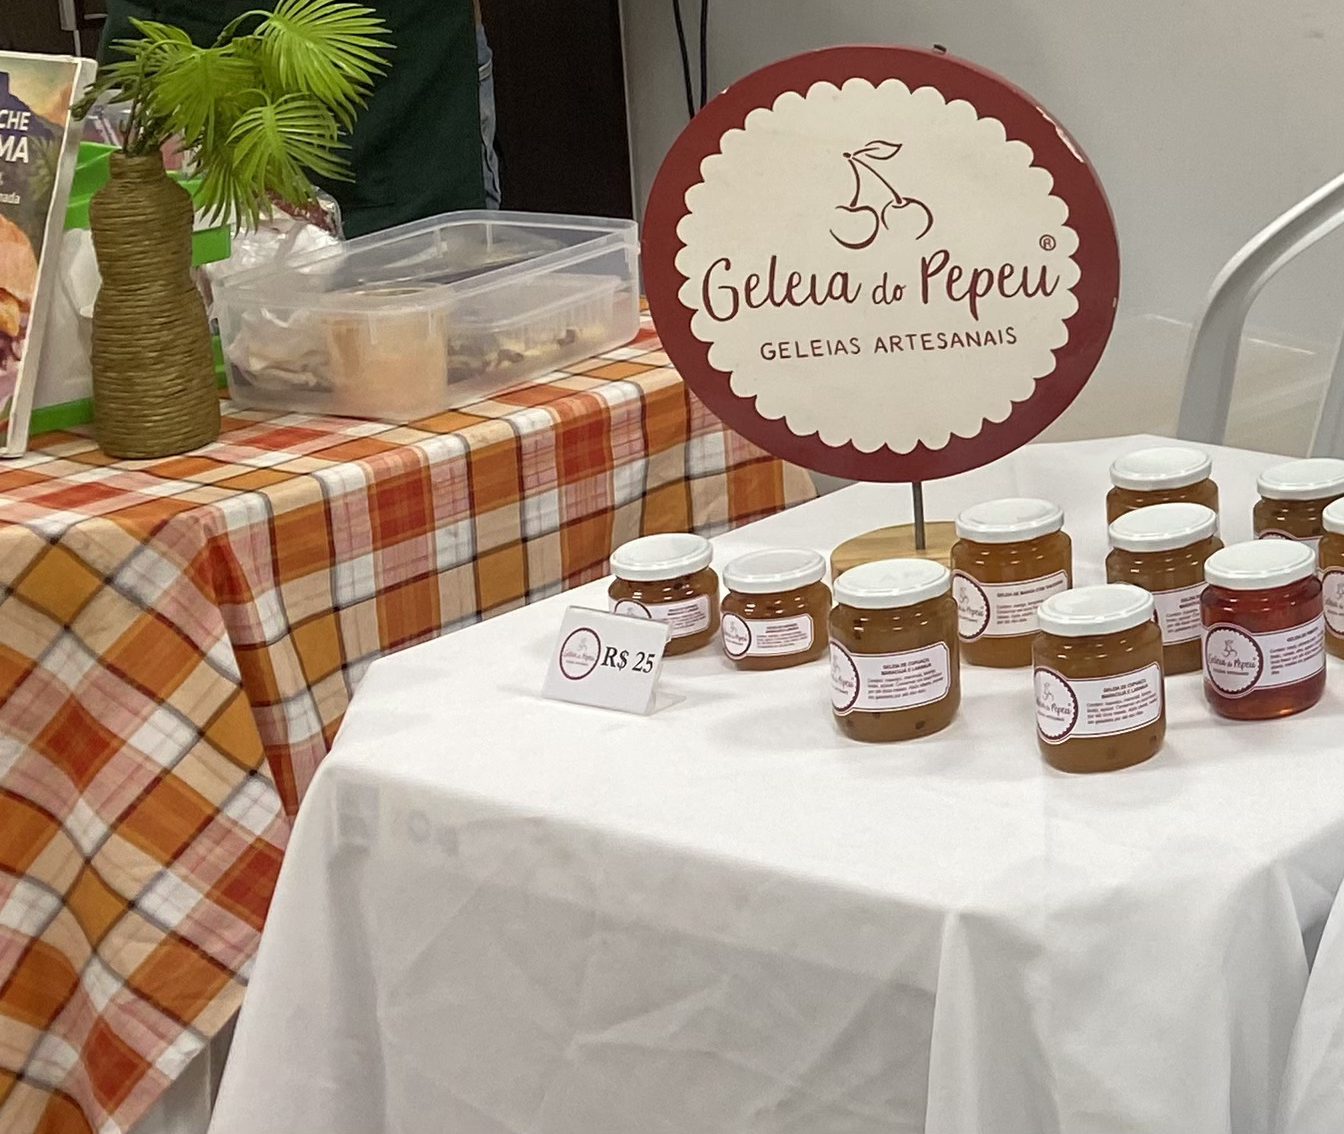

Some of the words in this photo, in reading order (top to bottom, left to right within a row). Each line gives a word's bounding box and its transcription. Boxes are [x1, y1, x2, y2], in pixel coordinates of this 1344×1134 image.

[702, 255, 862, 322] Geleia
[872, 272, 907, 306] do
[921, 249, 1060, 322] Pepeu
[760, 337, 862, 361] GELEIAS
[873, 326, 1018, 355] ARTESANAIS
[601, 646, 629, 671] R$
[632, 651, 655, 673] 25
